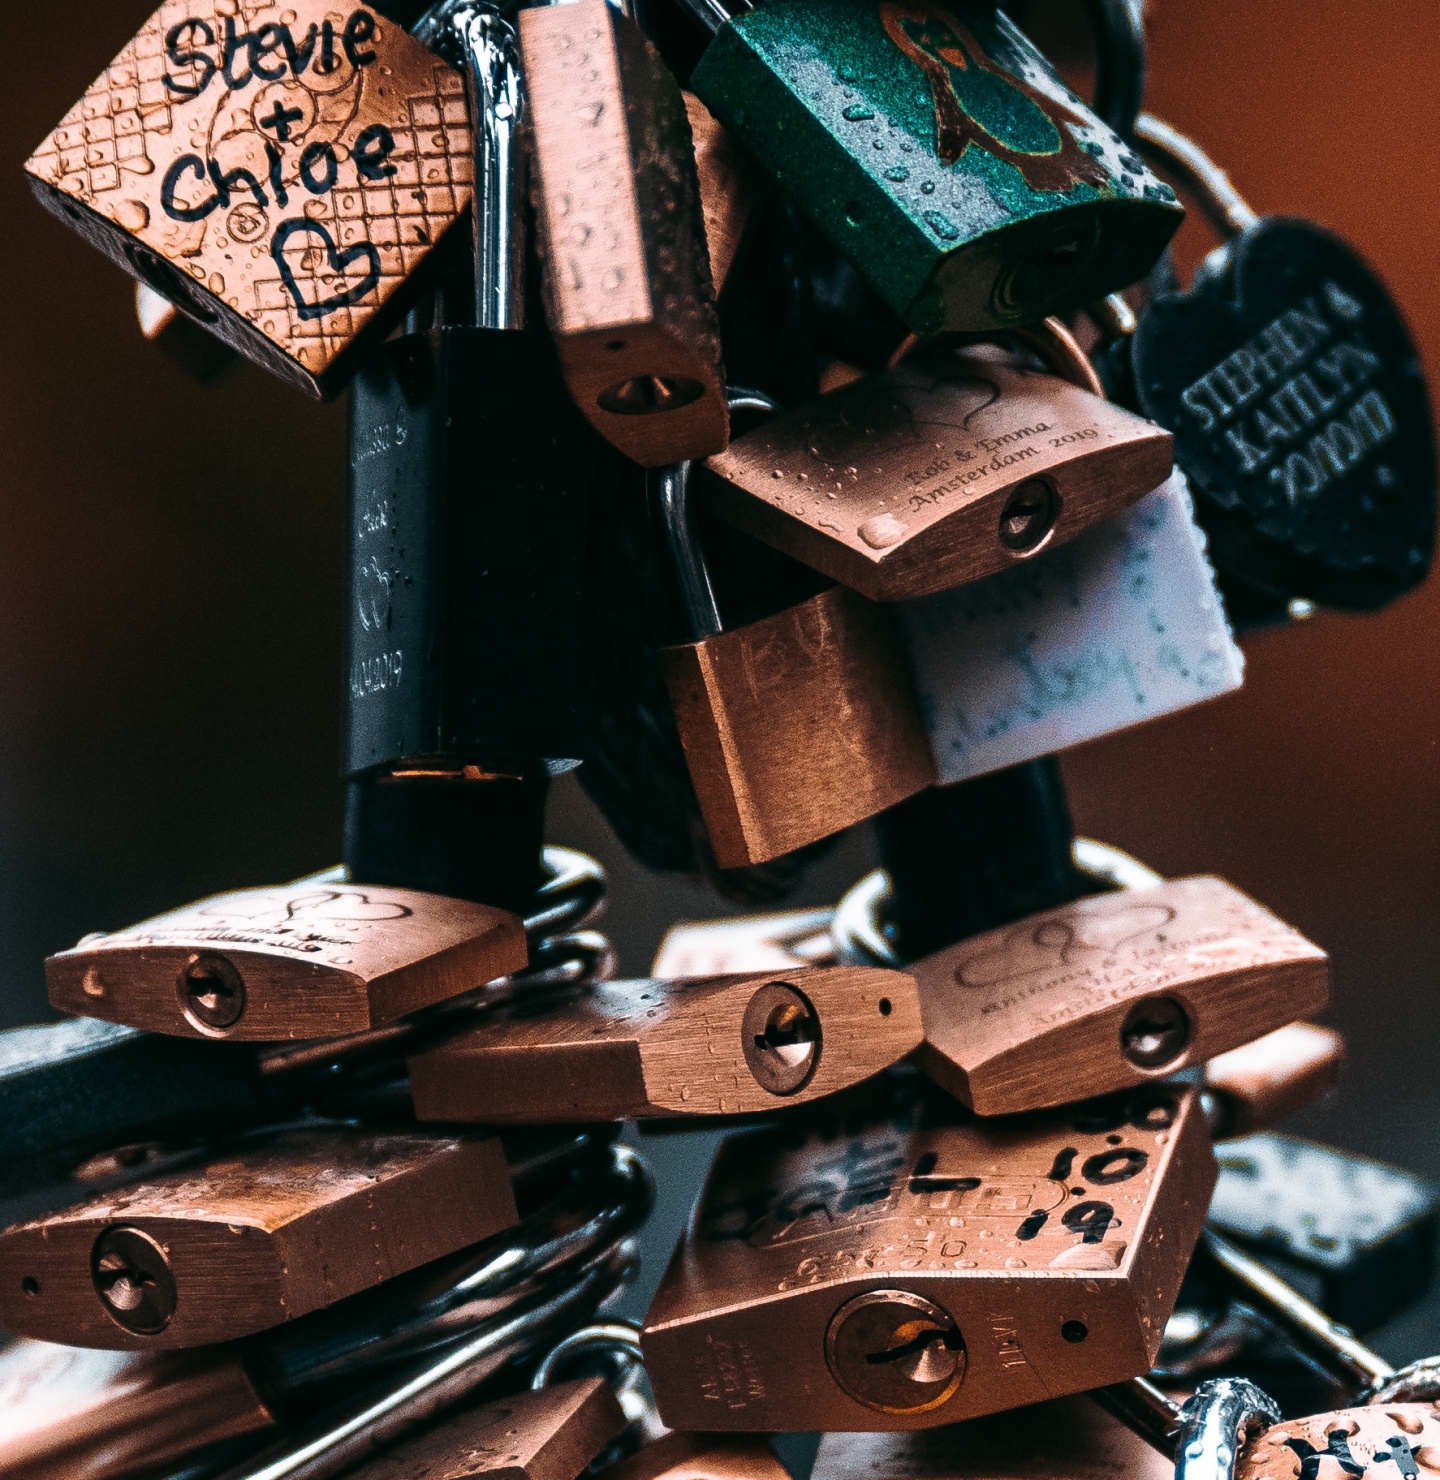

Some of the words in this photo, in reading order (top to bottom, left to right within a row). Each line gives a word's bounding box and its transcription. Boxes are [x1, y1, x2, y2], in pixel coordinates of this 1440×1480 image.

[163, 9, 377, 95] Stevie
[261, 100, 302, 142] +
[161, 124, 398, 222] Chloe
[1181, 297, 1332, 430] STEPHEN
[954, 449, 976, 463] &
[975, 420, 1053, 453] Emma
[1225, 343, 1381, 472] KAITLYN
[908, 446, 1040, 513] Amsterdam
[1049, 427, 1101, 449] 2019
